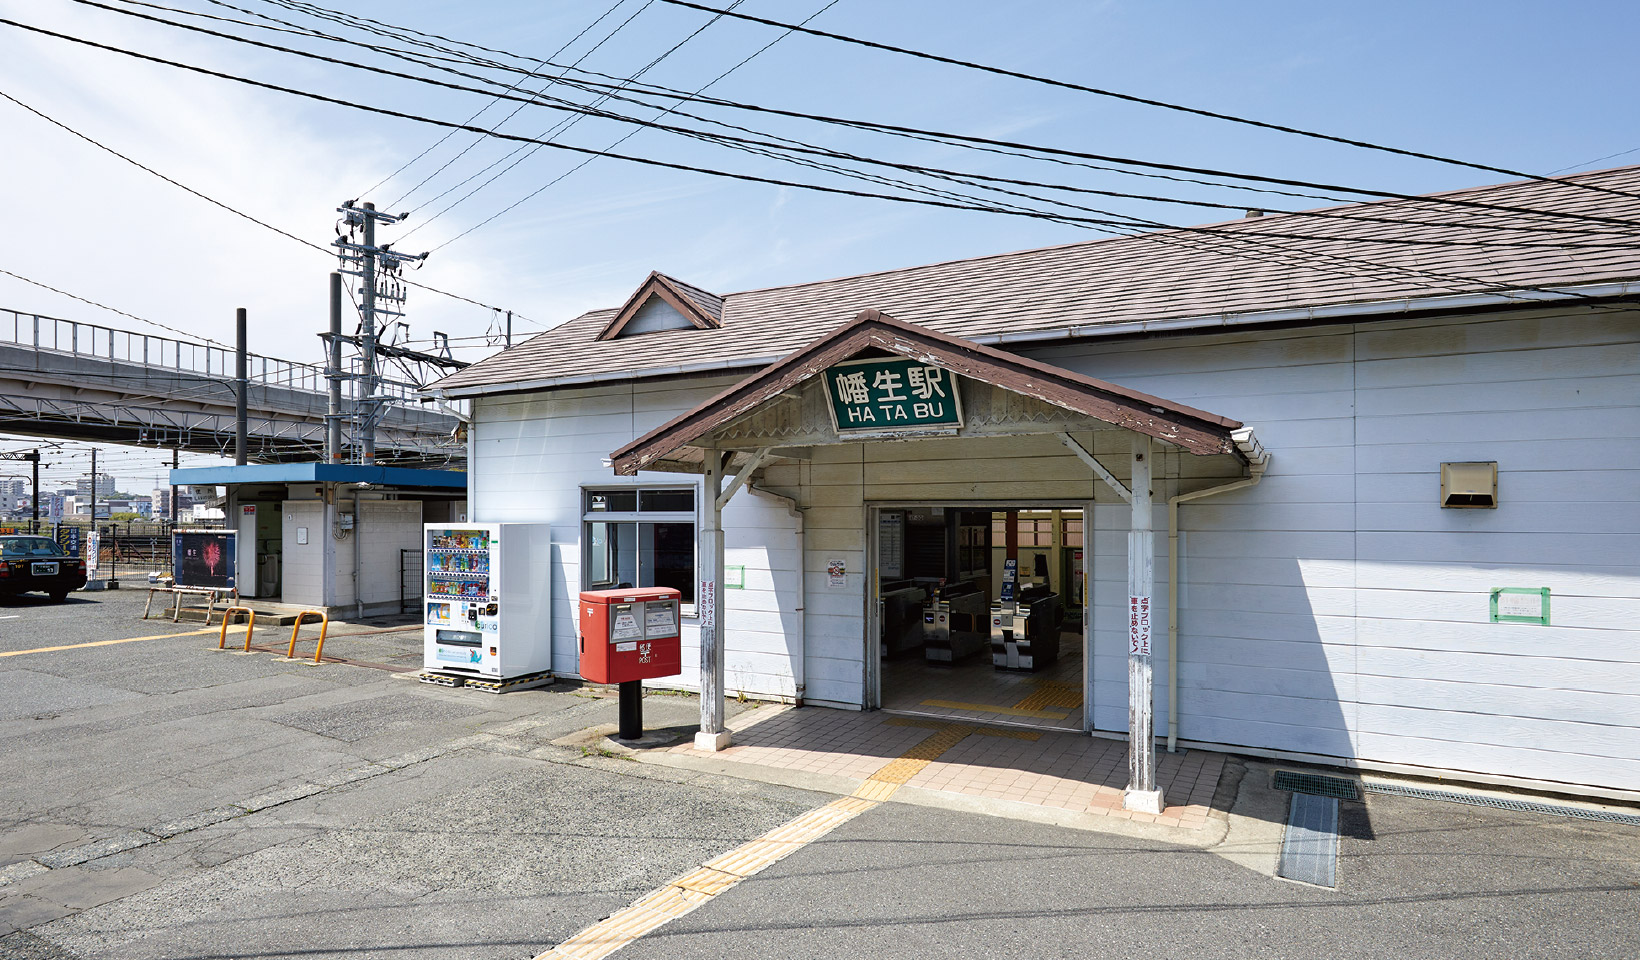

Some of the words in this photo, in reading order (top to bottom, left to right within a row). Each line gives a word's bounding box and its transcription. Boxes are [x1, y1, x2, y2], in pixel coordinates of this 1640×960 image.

[835, 366, 946, 405] 幡生駅
[847, 406, 876, 423] HA
[879, 404, 908, 421] TA
[913, 402, 944, 419] BU
[1140, 597, 1149, 654] 点字ブロック上に
[638, 656, 652, 664] POST
